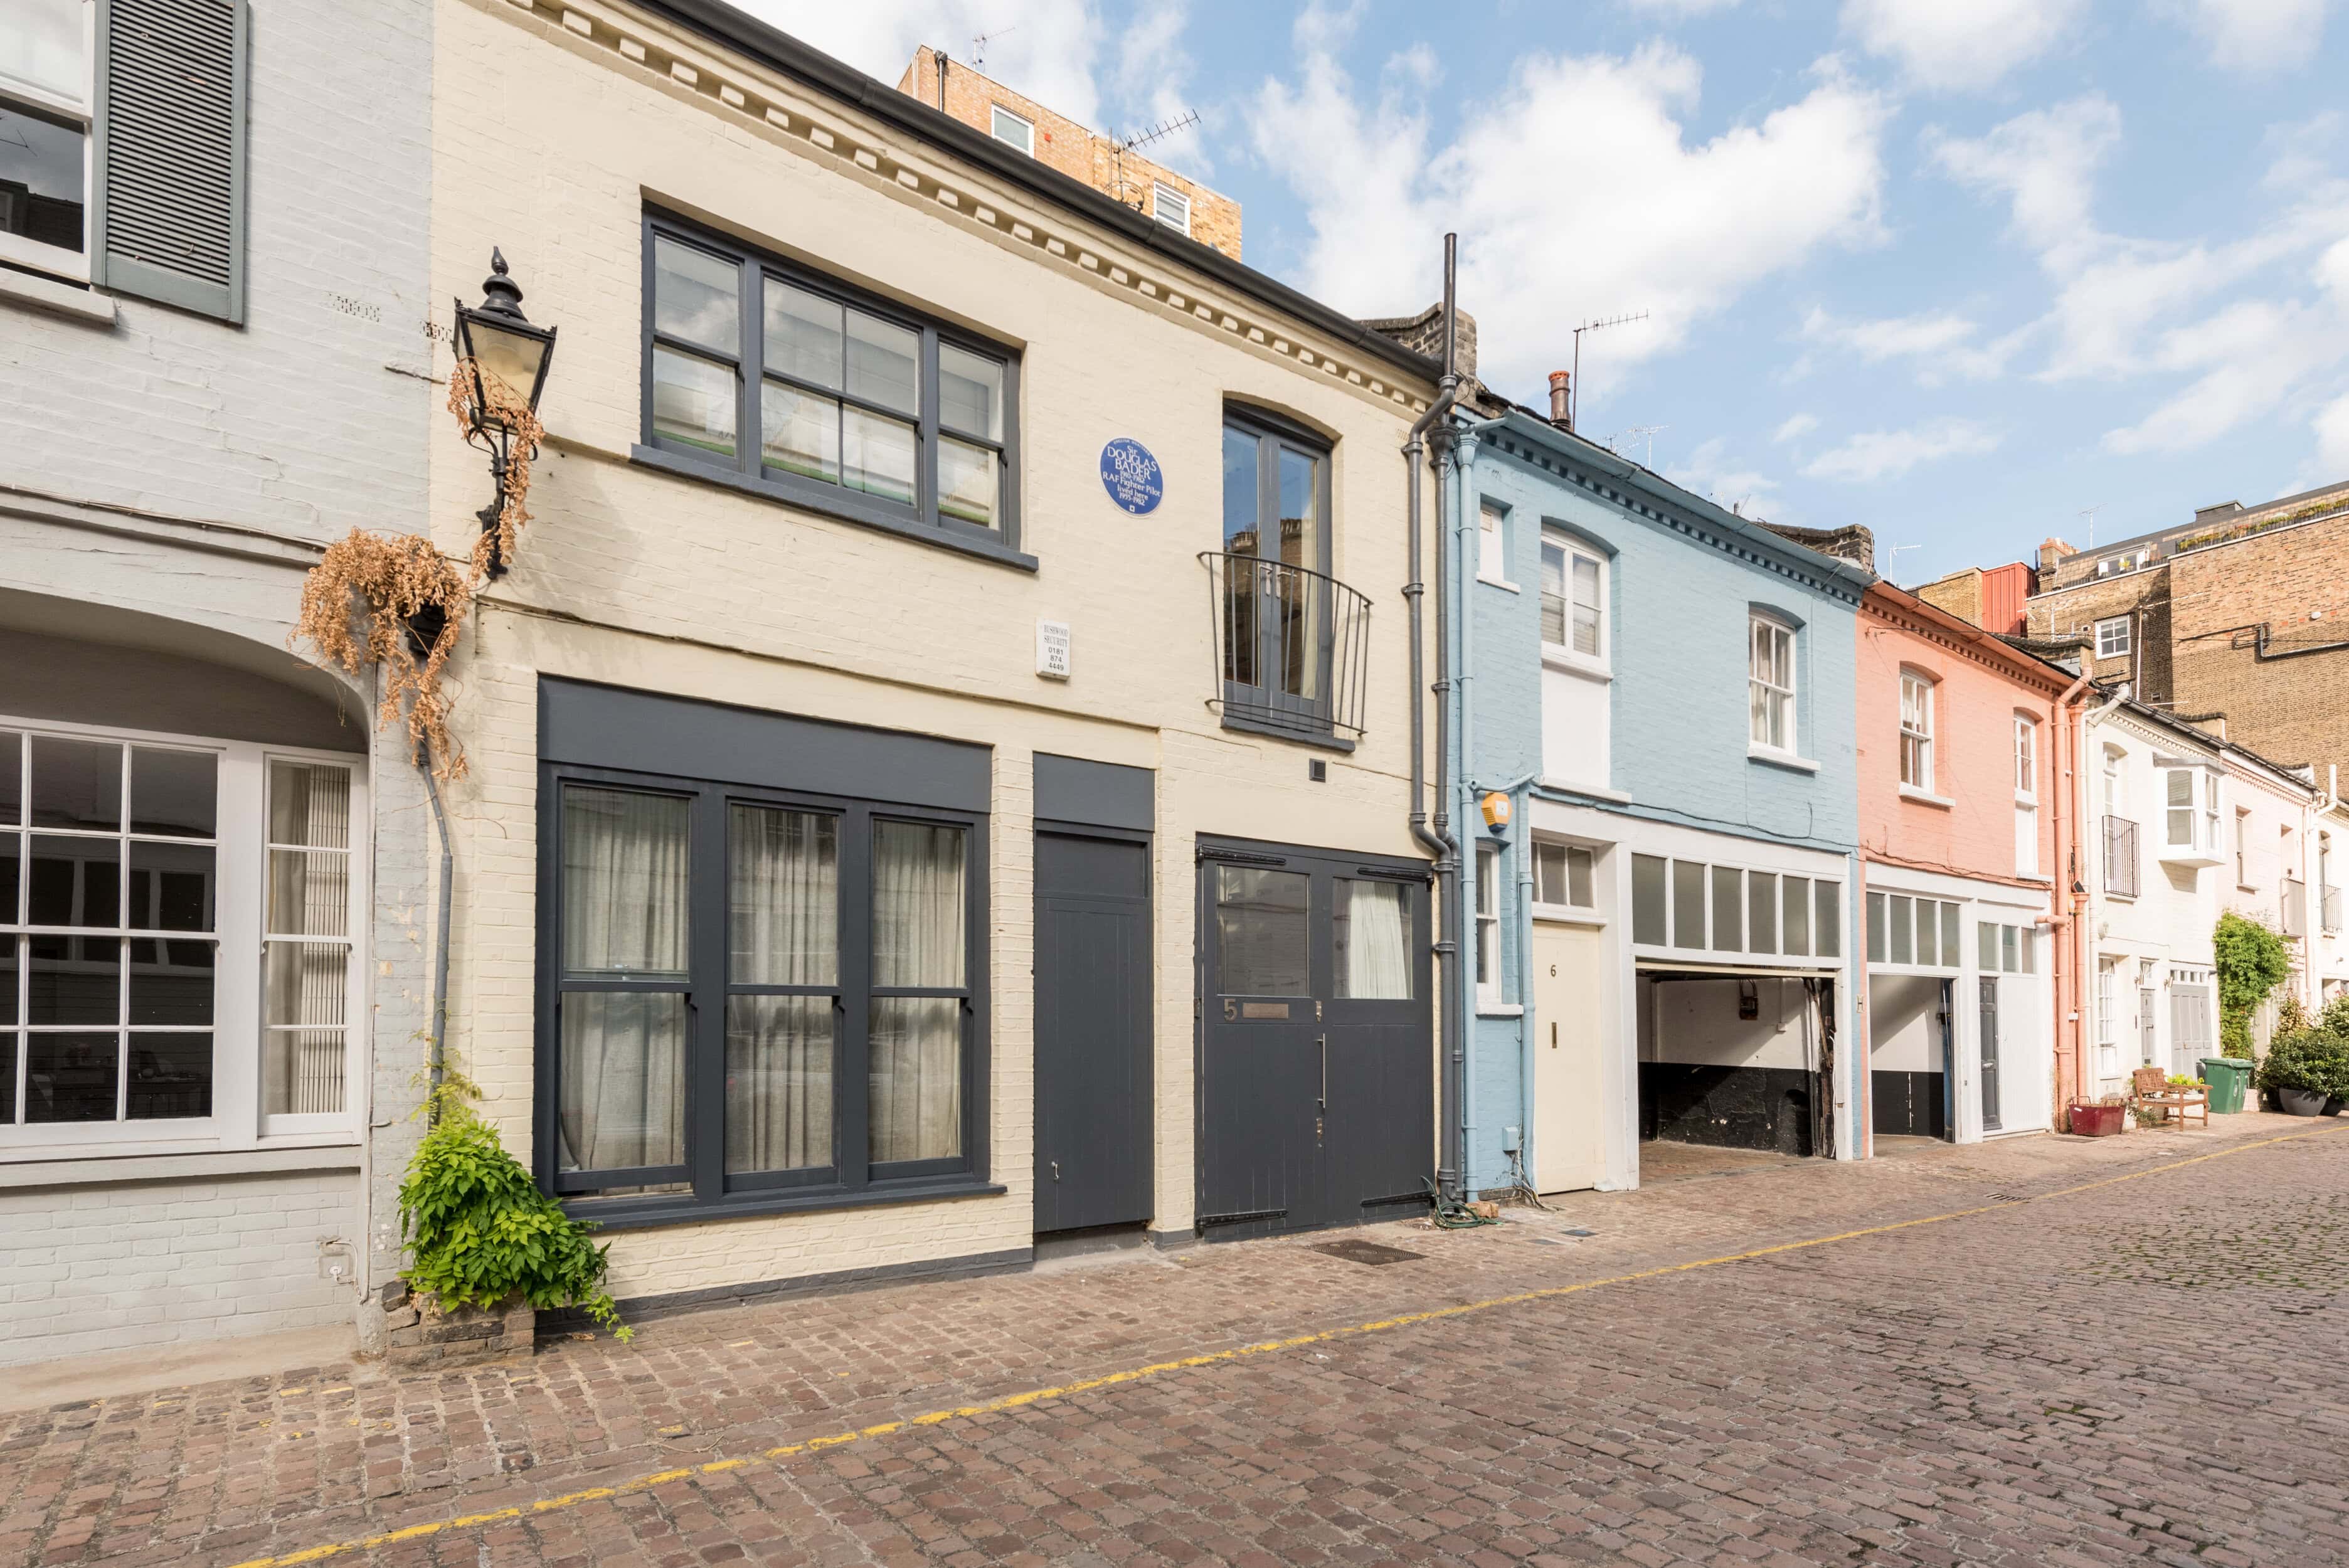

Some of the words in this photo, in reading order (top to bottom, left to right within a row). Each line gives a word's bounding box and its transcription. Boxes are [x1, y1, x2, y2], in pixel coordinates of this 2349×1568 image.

[1127, 445, 1138, 454] Sir
[1108, 446, 1157, 472] DOUGLAS
[1115, 458, 1151, 480] BADER
[1103, 472, 1120, 482] RAF
[1120, 477, 1145, 491] Fighter
[1146, 485, 1161, 497] Pilot
[1117, 484, 1133, 495] lived
[1135, 492, 1148, 500] here
[1044, 635, 1068, 647] SECURITY
[1049, 647, 1064, 655] 0181
[1049, 662, 1064, 670] 4449
[1551, 965, 1557, 977] 6
[1224, 999, 1238, 1022] 5
